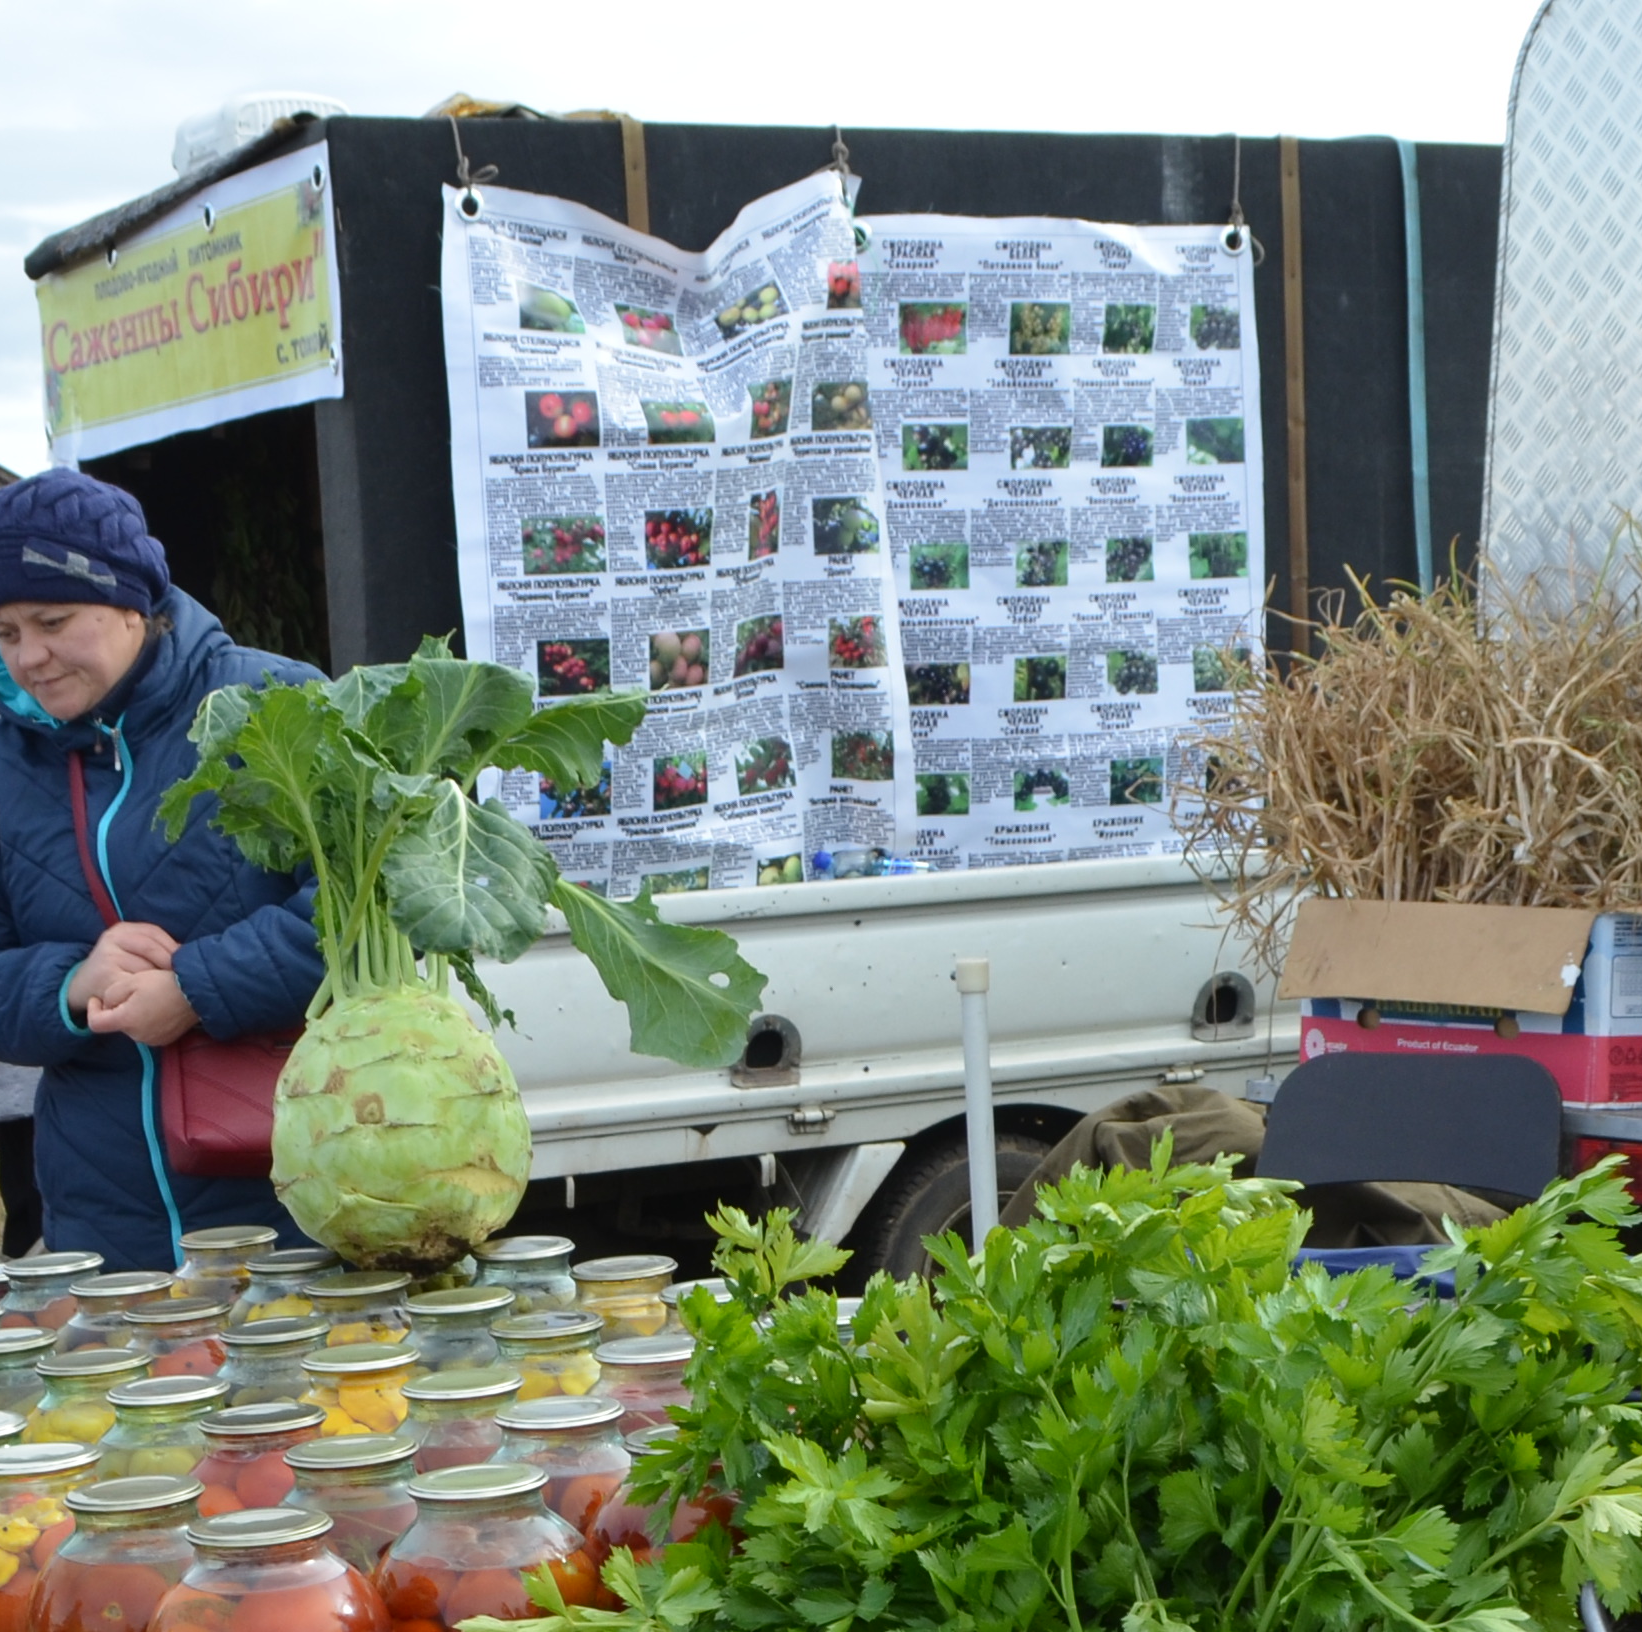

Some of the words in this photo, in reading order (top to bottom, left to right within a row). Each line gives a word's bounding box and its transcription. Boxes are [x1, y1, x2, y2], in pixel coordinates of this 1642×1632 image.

[898, 598, 949, 608] МОРОДИНА
[1397, 1037, 1430, 1050] Product
[1432, 1040, 1441, 1050] of
[1442, 1041, 1479, 1054] Ecuador
